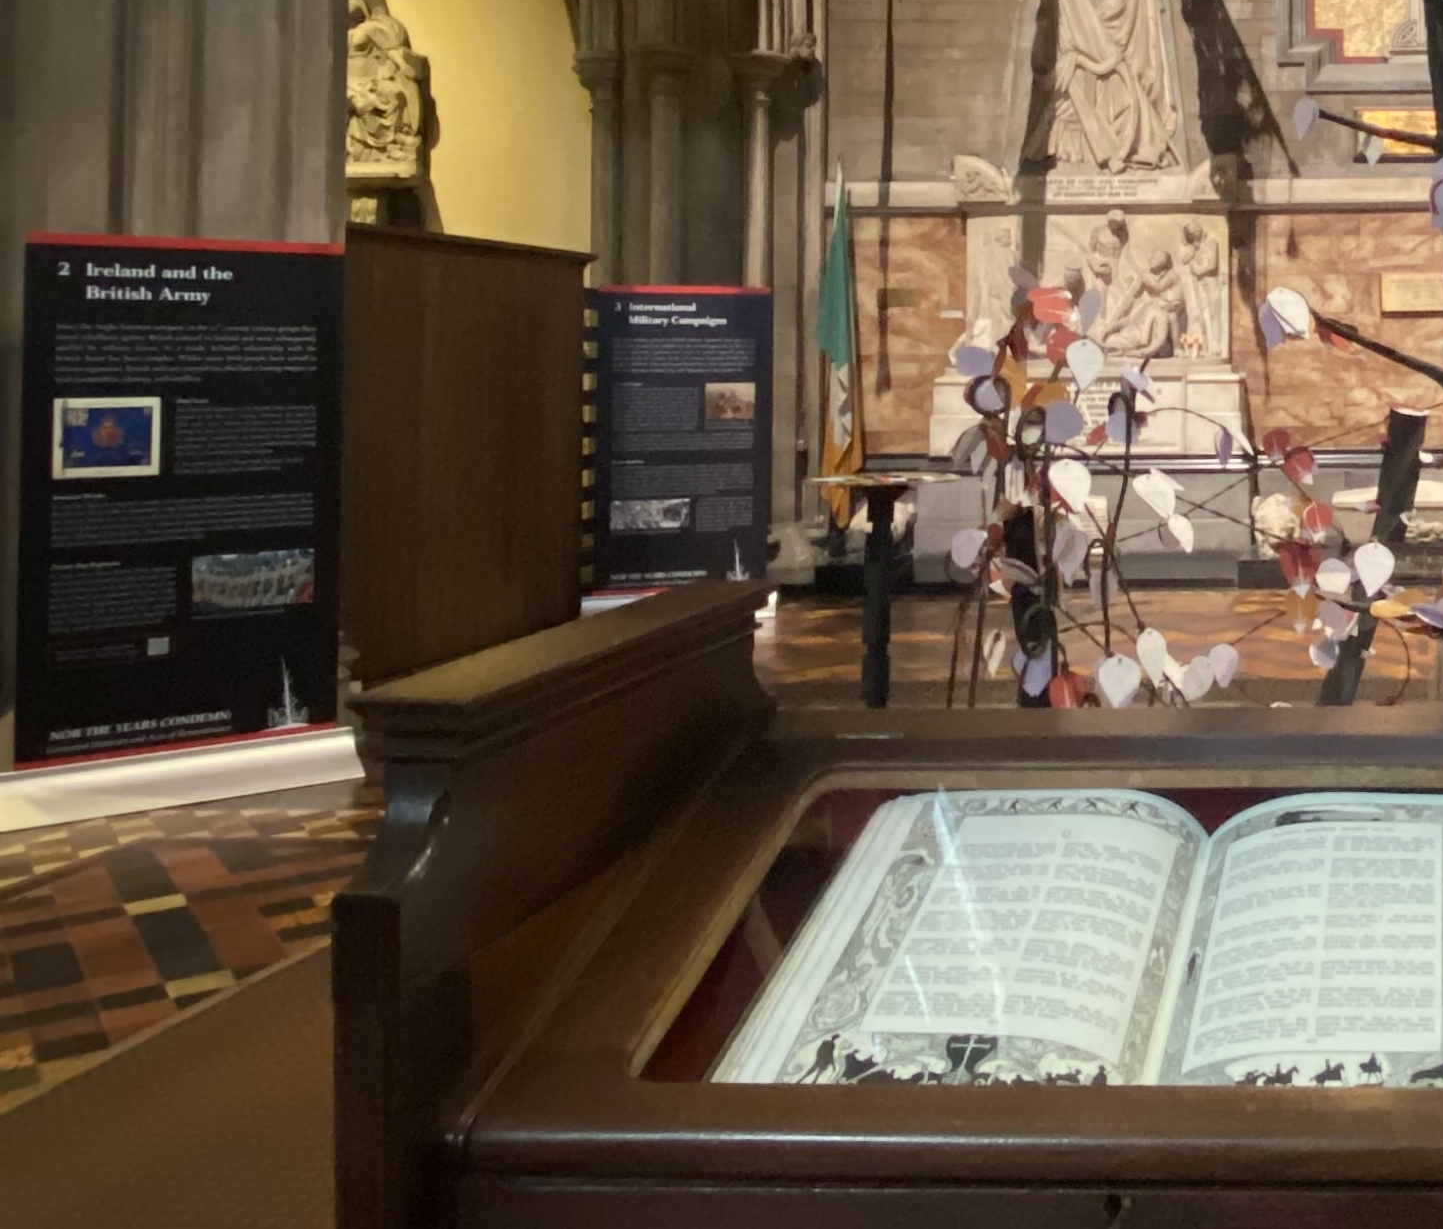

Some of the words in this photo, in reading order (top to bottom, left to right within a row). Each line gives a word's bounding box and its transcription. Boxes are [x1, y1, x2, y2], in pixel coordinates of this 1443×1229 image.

[57, 262, 70, 276] 2
[86, 262, 156, 278] Ireland
[162, 266, 196, 279] and
[203, 266, 233, 281] the
[86, 285, 152, 300] British
[158, 287, 211, 306] Army
[629, 302, 696, 312] International
[629, 315, 669, 327] Military
[671, 315, 727, 327] Campaigns
[115, 719, 157, 733] YEARS
